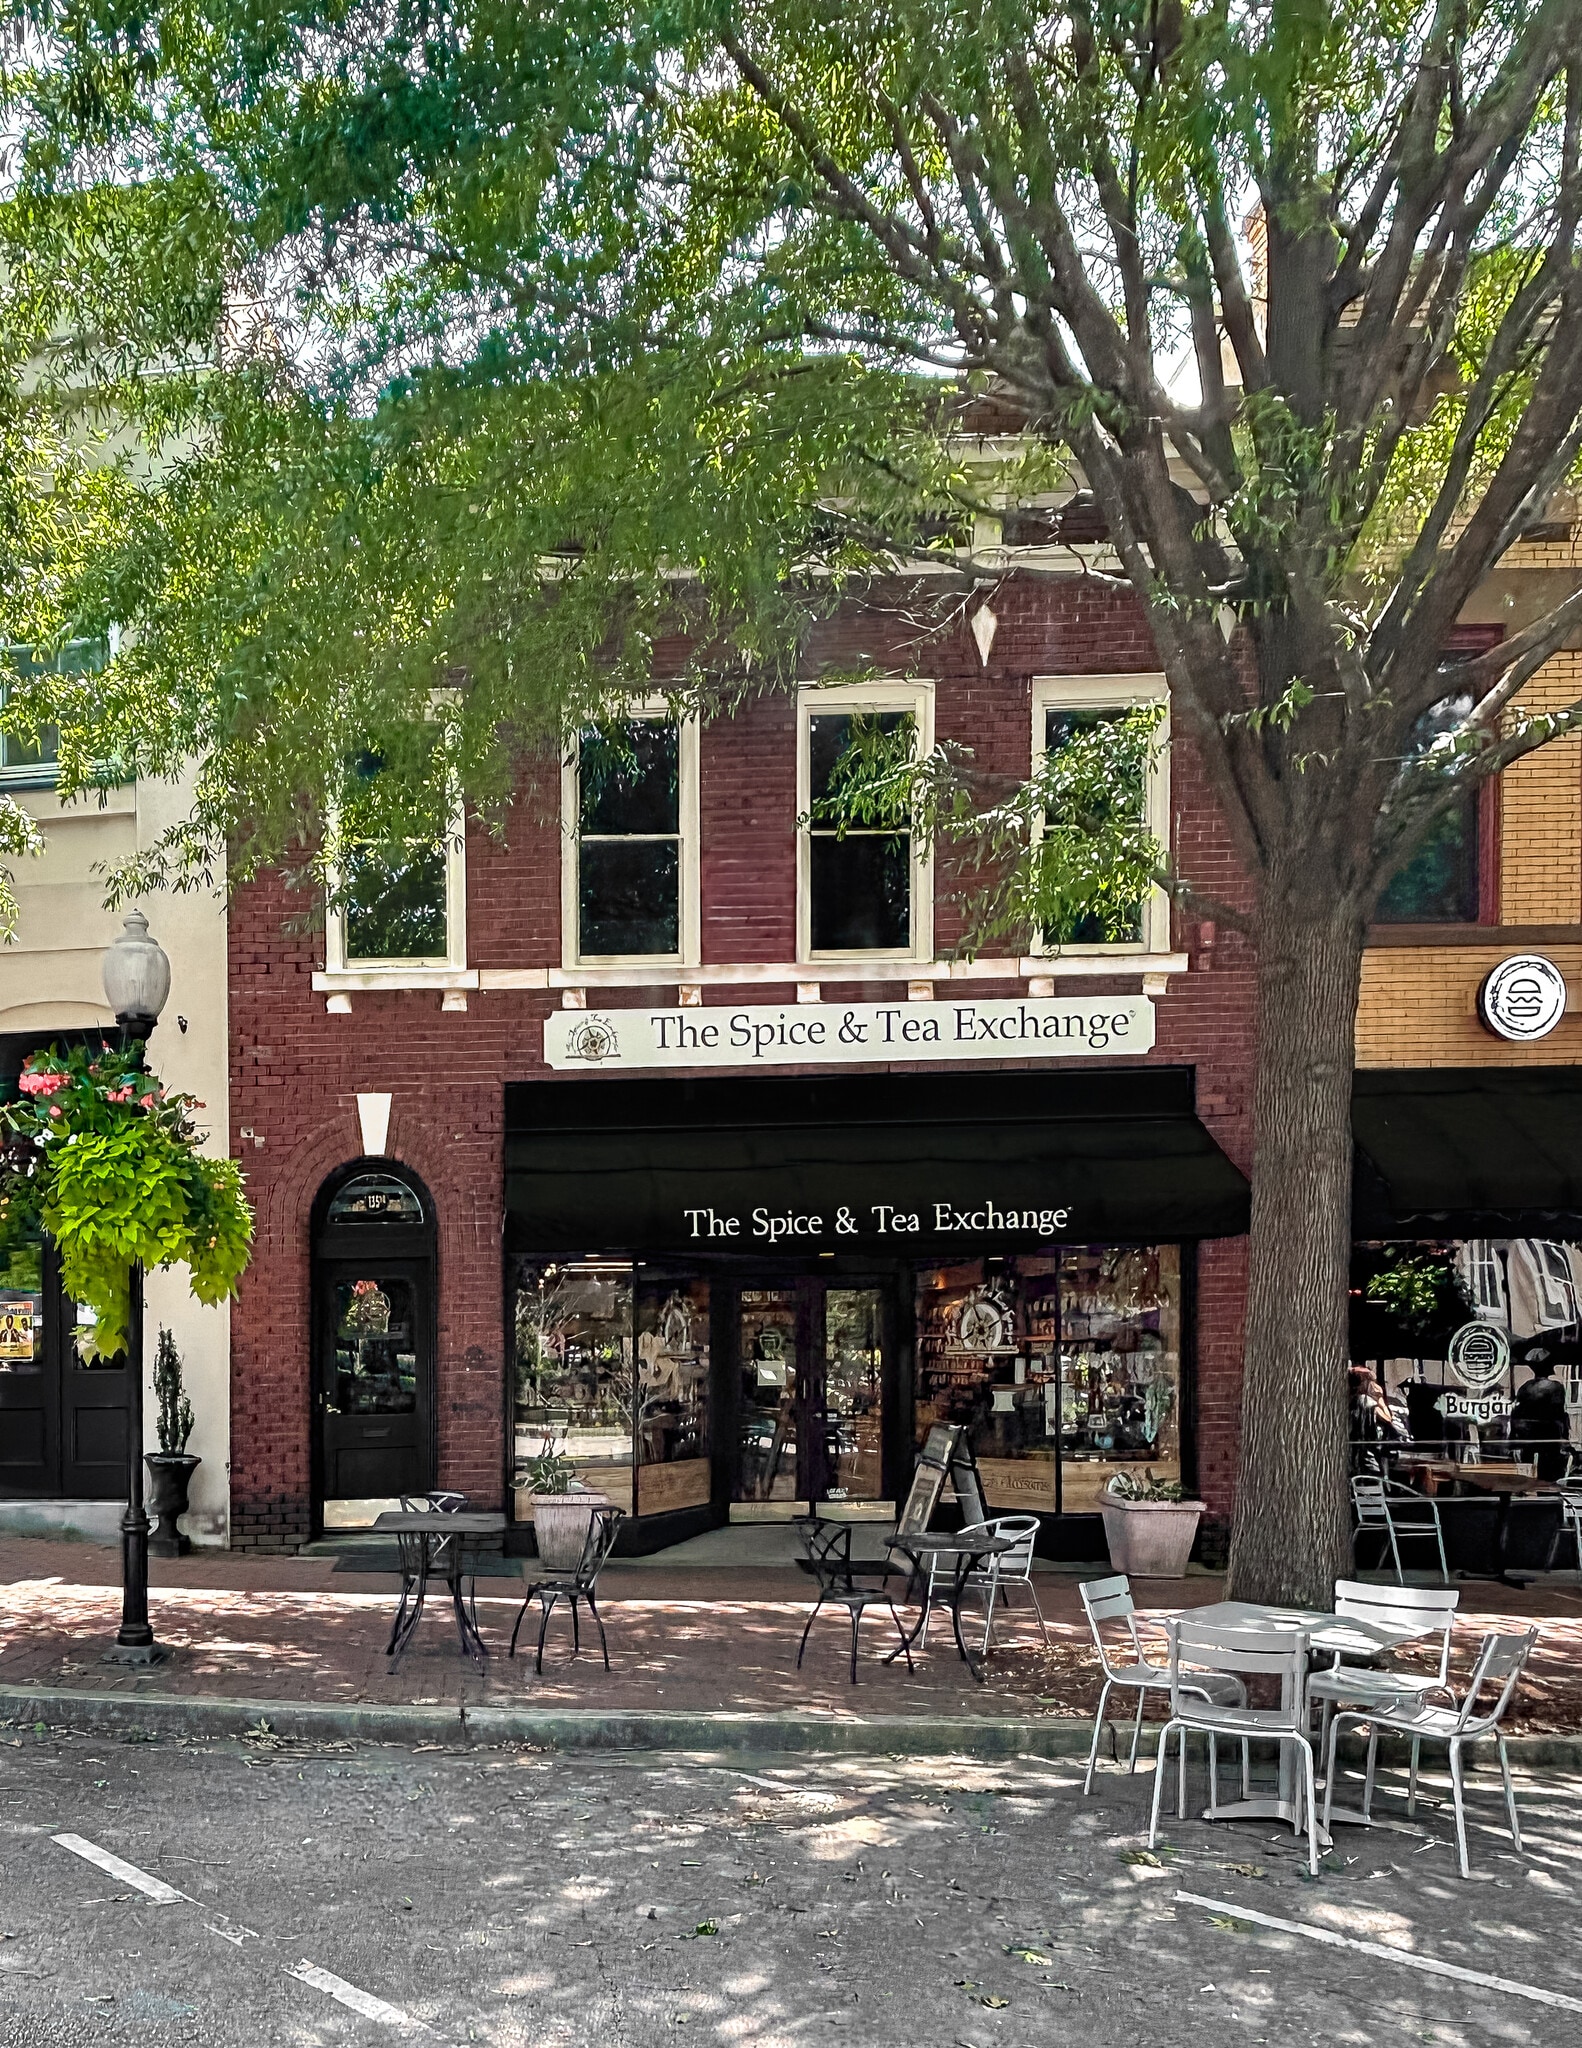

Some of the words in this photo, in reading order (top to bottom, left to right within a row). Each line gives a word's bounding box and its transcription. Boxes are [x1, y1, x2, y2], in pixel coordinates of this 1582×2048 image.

[650, 1015, 719, 1049] The
[729, 1013, 826, 1058] Spice
[838, 1011, 869, 1044] &
[875, 1009, 942, 1043] Tea
[683, 1208, 741, 1237] The
[752, 1207, 823, 1243] Spice
[835, 1206, 859, 1235] &
[871, 1205, 920, 1233] Tea
